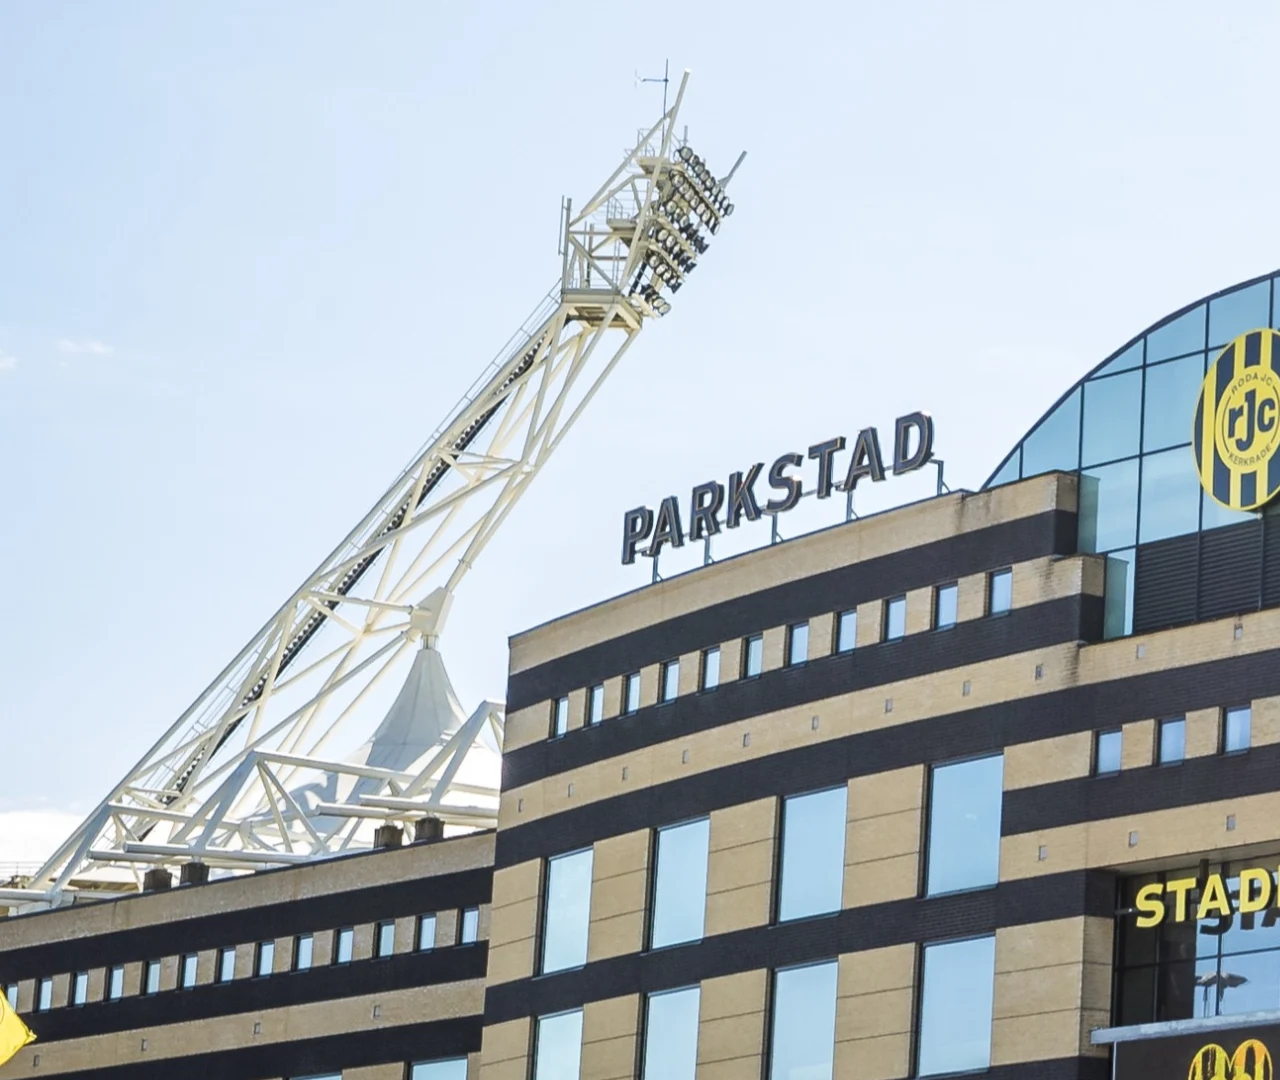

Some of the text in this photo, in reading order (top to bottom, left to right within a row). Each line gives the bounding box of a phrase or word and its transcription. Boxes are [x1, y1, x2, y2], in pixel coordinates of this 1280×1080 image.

[1231, 372, 1274, 396] RODA JC
[1228, 444, 1273, 466] KERKRADE
[622, 410, 934, 565] PARKSTAD
